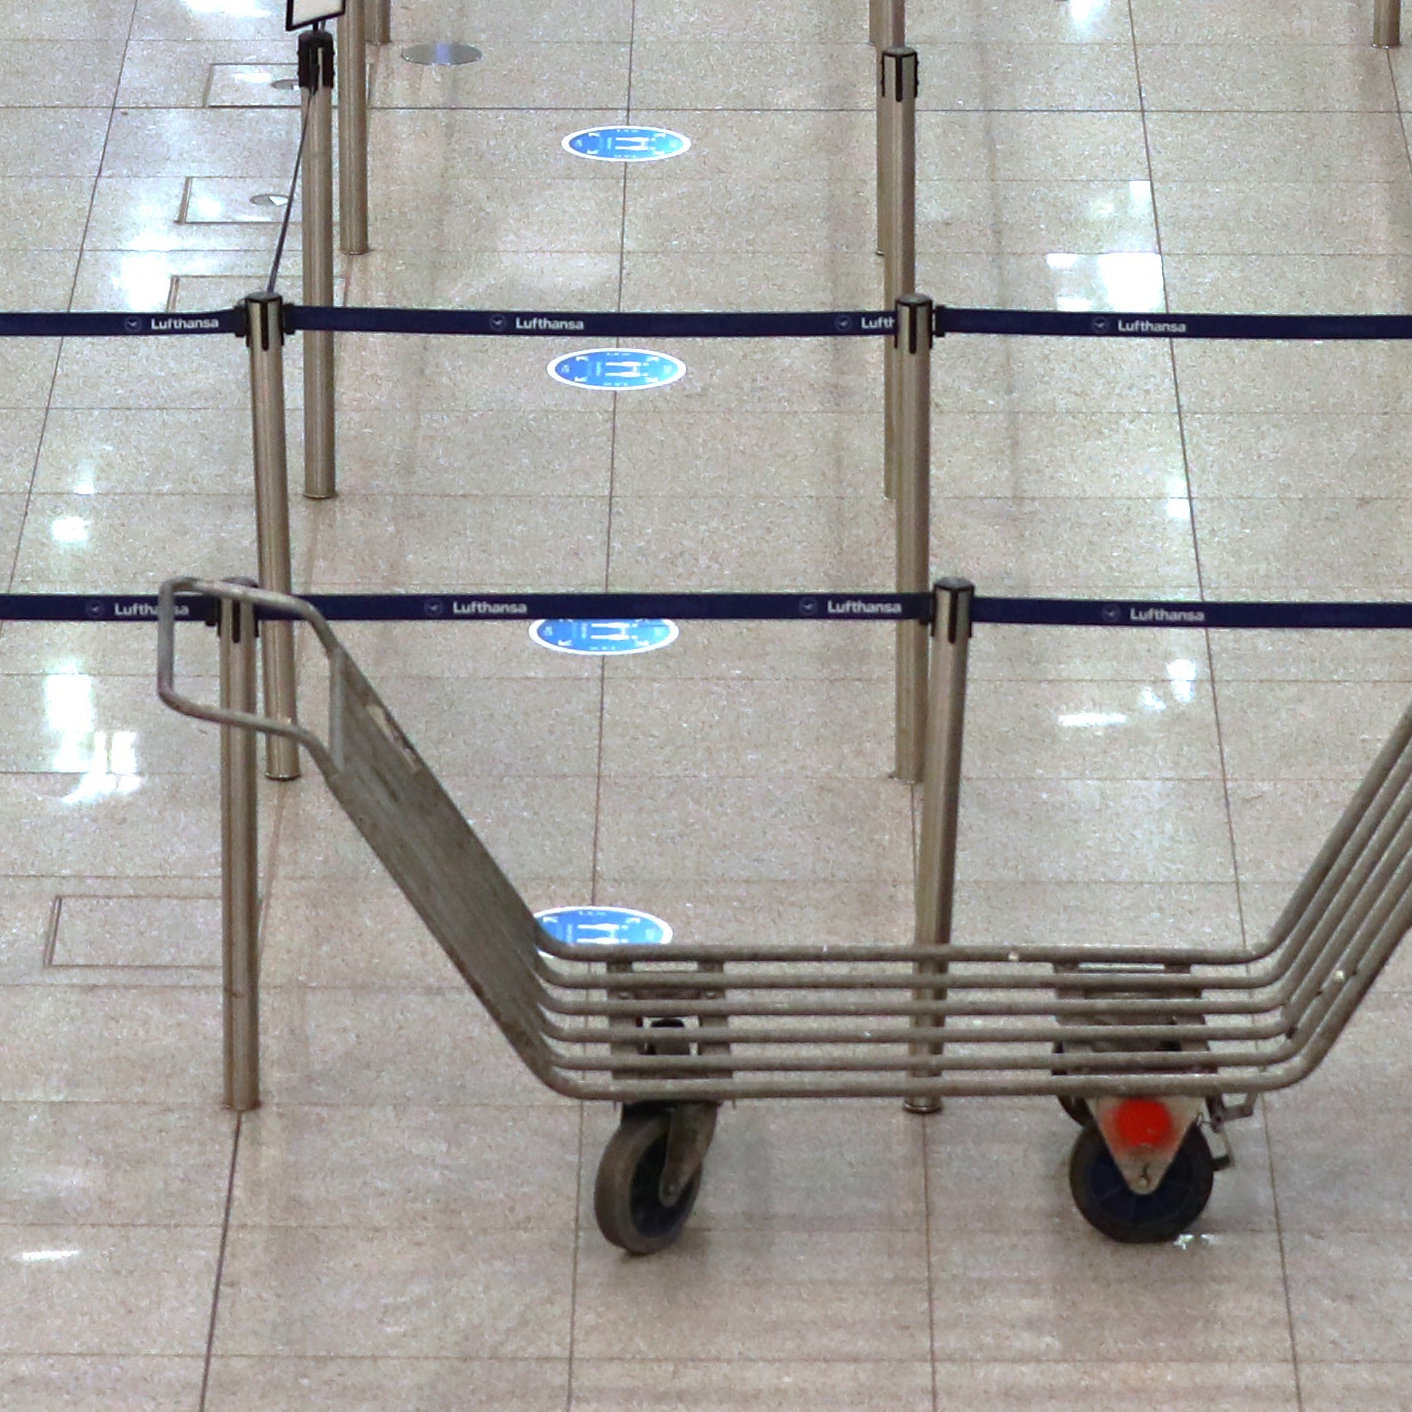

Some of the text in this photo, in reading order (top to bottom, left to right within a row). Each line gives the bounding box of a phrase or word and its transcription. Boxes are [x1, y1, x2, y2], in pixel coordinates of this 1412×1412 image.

[150, 316, 219, 330] Lufthansa
[515, 317, 584, 331] Lufthansa
[1117, 319, 1187, 333] Lufthansa
[453, 601, 527, 615] Lufthansa
[828, 600, 902, 614] Lufthansa
[1130, 608, 1205, 622] Lufthansa
